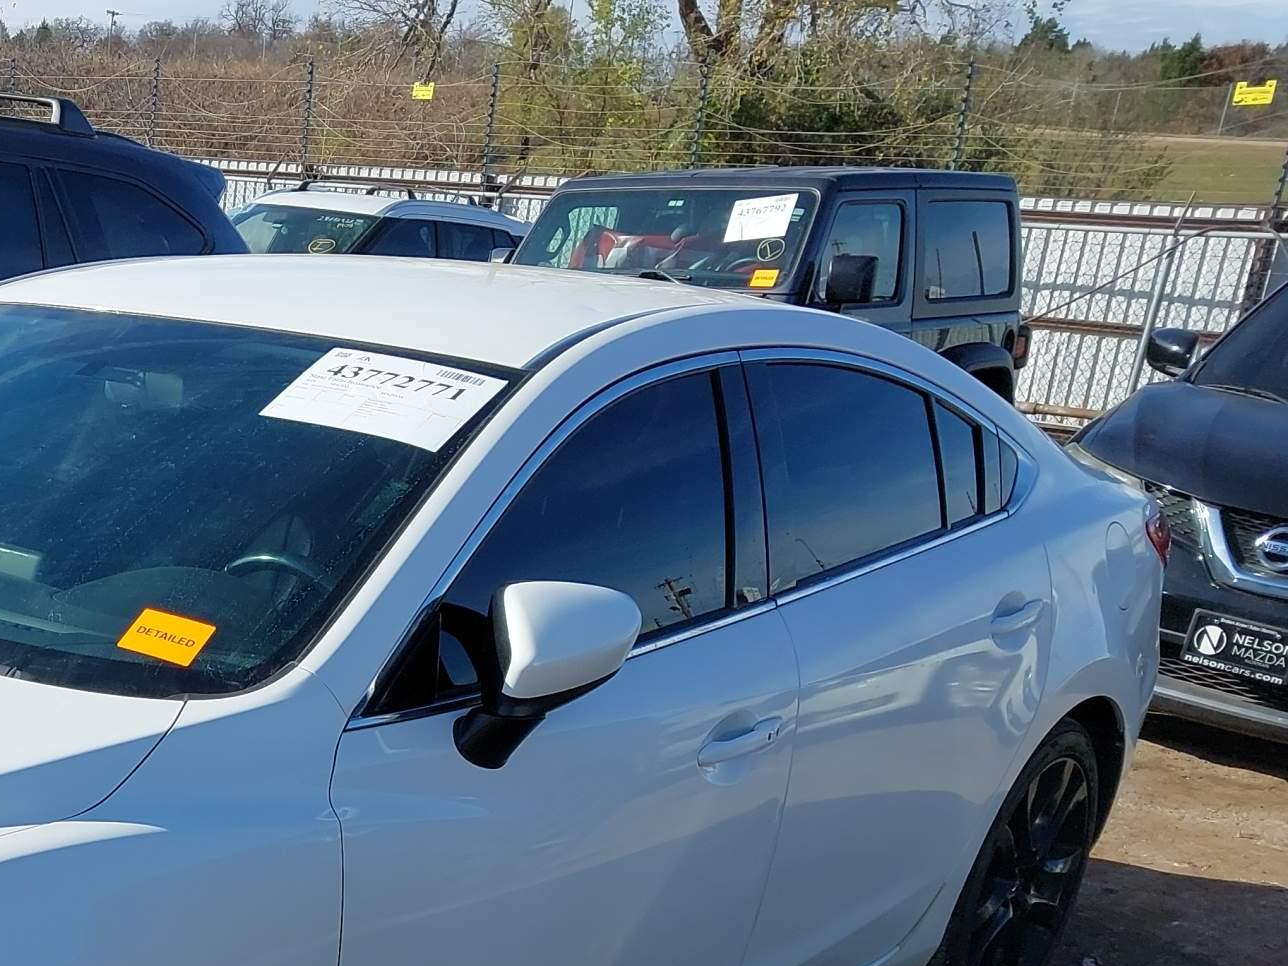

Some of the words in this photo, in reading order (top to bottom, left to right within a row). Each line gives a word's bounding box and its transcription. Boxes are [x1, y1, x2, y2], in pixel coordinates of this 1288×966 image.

[327, 363, 467, 401] 43772771
[136, 625, 196, 648] DETAILED
[1184, 654, 1284, 685] nelsoncars.com
[1232, 645, 1286, 668] MAZDA
